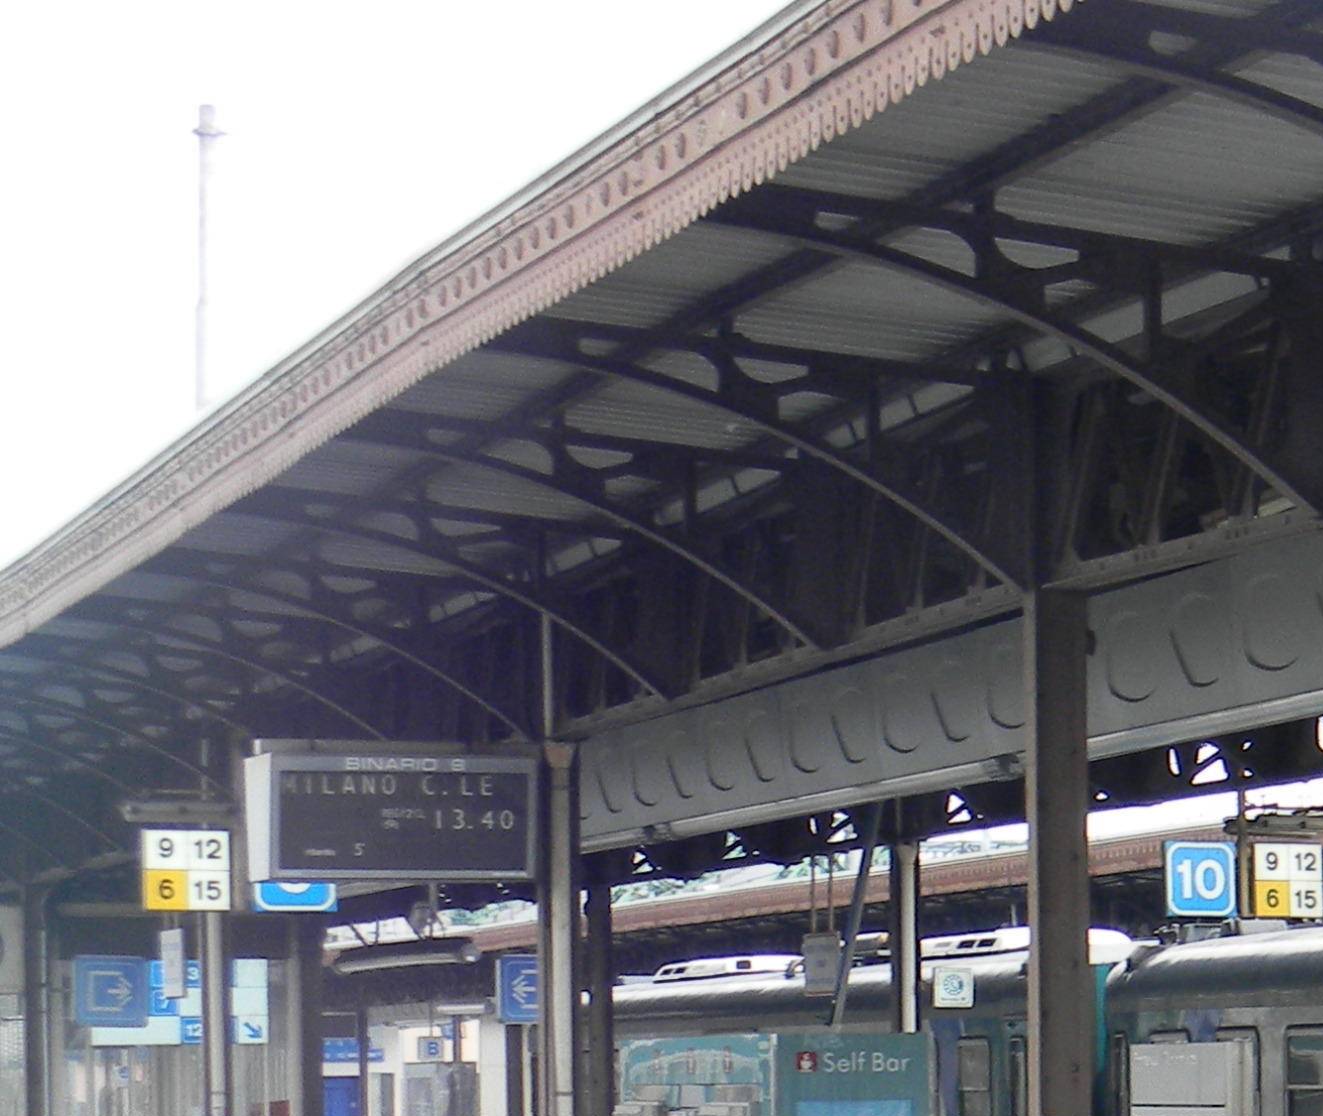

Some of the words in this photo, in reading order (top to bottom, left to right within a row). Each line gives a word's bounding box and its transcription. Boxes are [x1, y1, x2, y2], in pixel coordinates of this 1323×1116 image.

[345, 757, 438, 772] BINARIO
[281, 775, 396, 796] MILANO
[434, 808, 515, 831] 13.40
[159, 838, 174, 858] 9
[194, 839, 222, 860] 12
[1265, 852, 1279, 871] 9
[1294, 852, 1317, 872] 12
[1177, 858, 1226, 900] 10
[158, 879, 175, 900] 6
[194, 880, 221, 901] 15
[1266, 889, 1280, 908] 6
[1294, 889, 1317, 909] 15
[822, 1051, 867, 1072] Self
[871, 1051, 911, 1072] Bar
